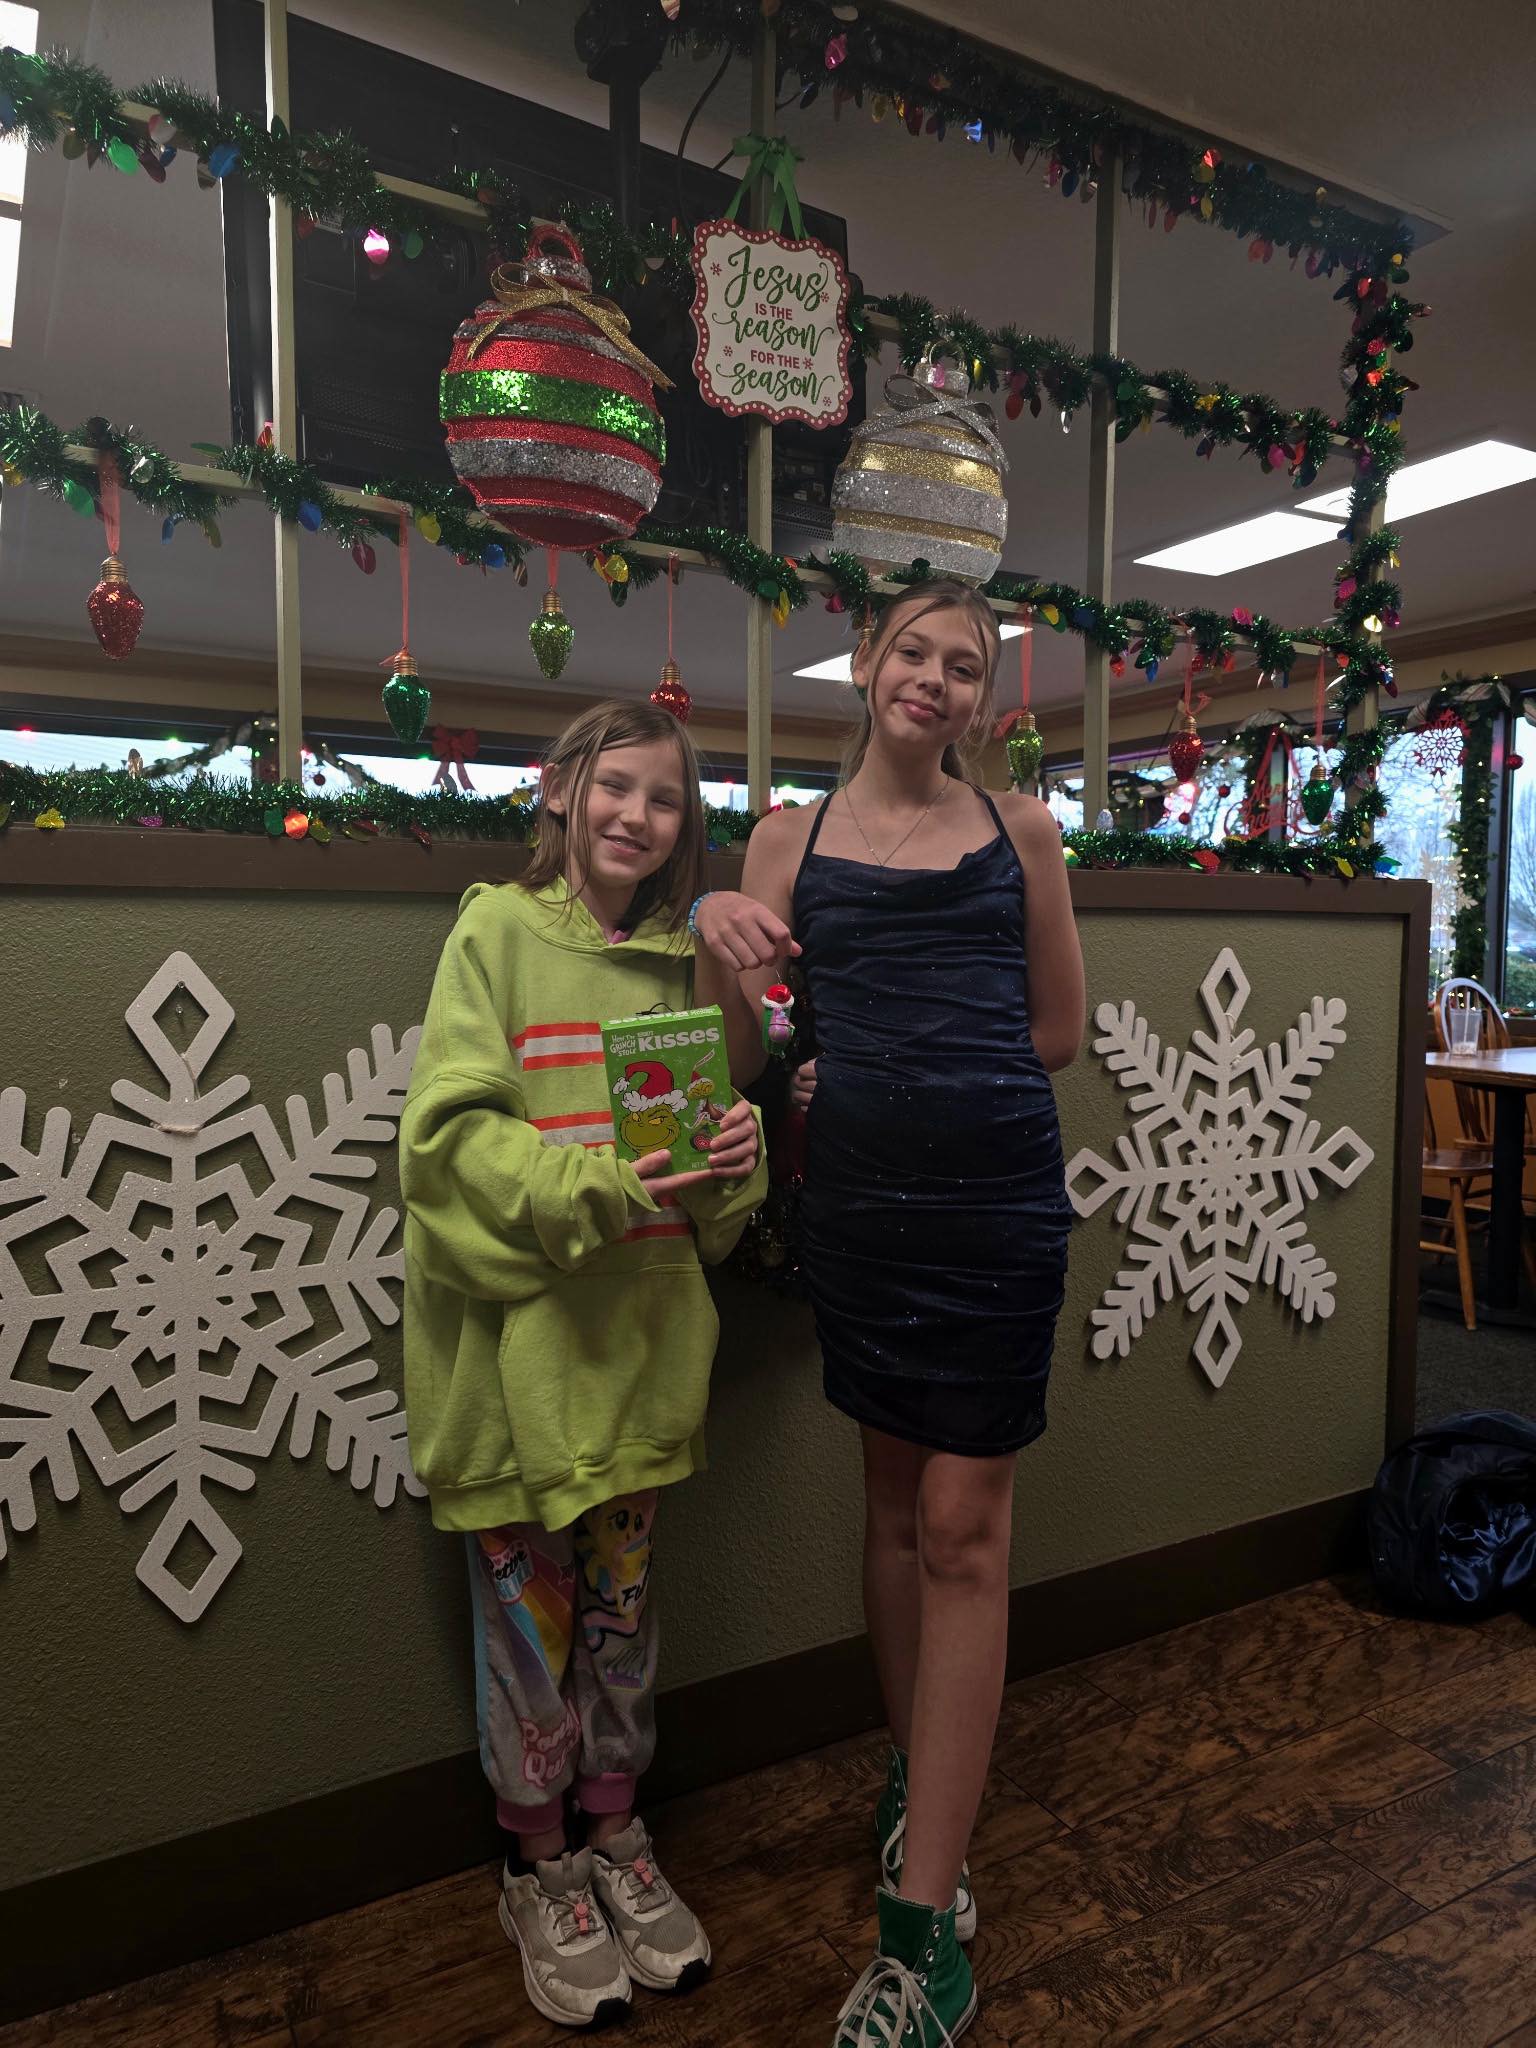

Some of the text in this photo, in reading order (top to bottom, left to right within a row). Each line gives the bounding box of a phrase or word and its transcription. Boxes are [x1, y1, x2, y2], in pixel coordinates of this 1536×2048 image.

[724, 245, 828, 311] Jesus
[755, 303, 793, 320] IS THE
[712, 310, 834, 356] reason
[750, 350, 800, 369] FOR THE
[715, 363, 835, 405] season
